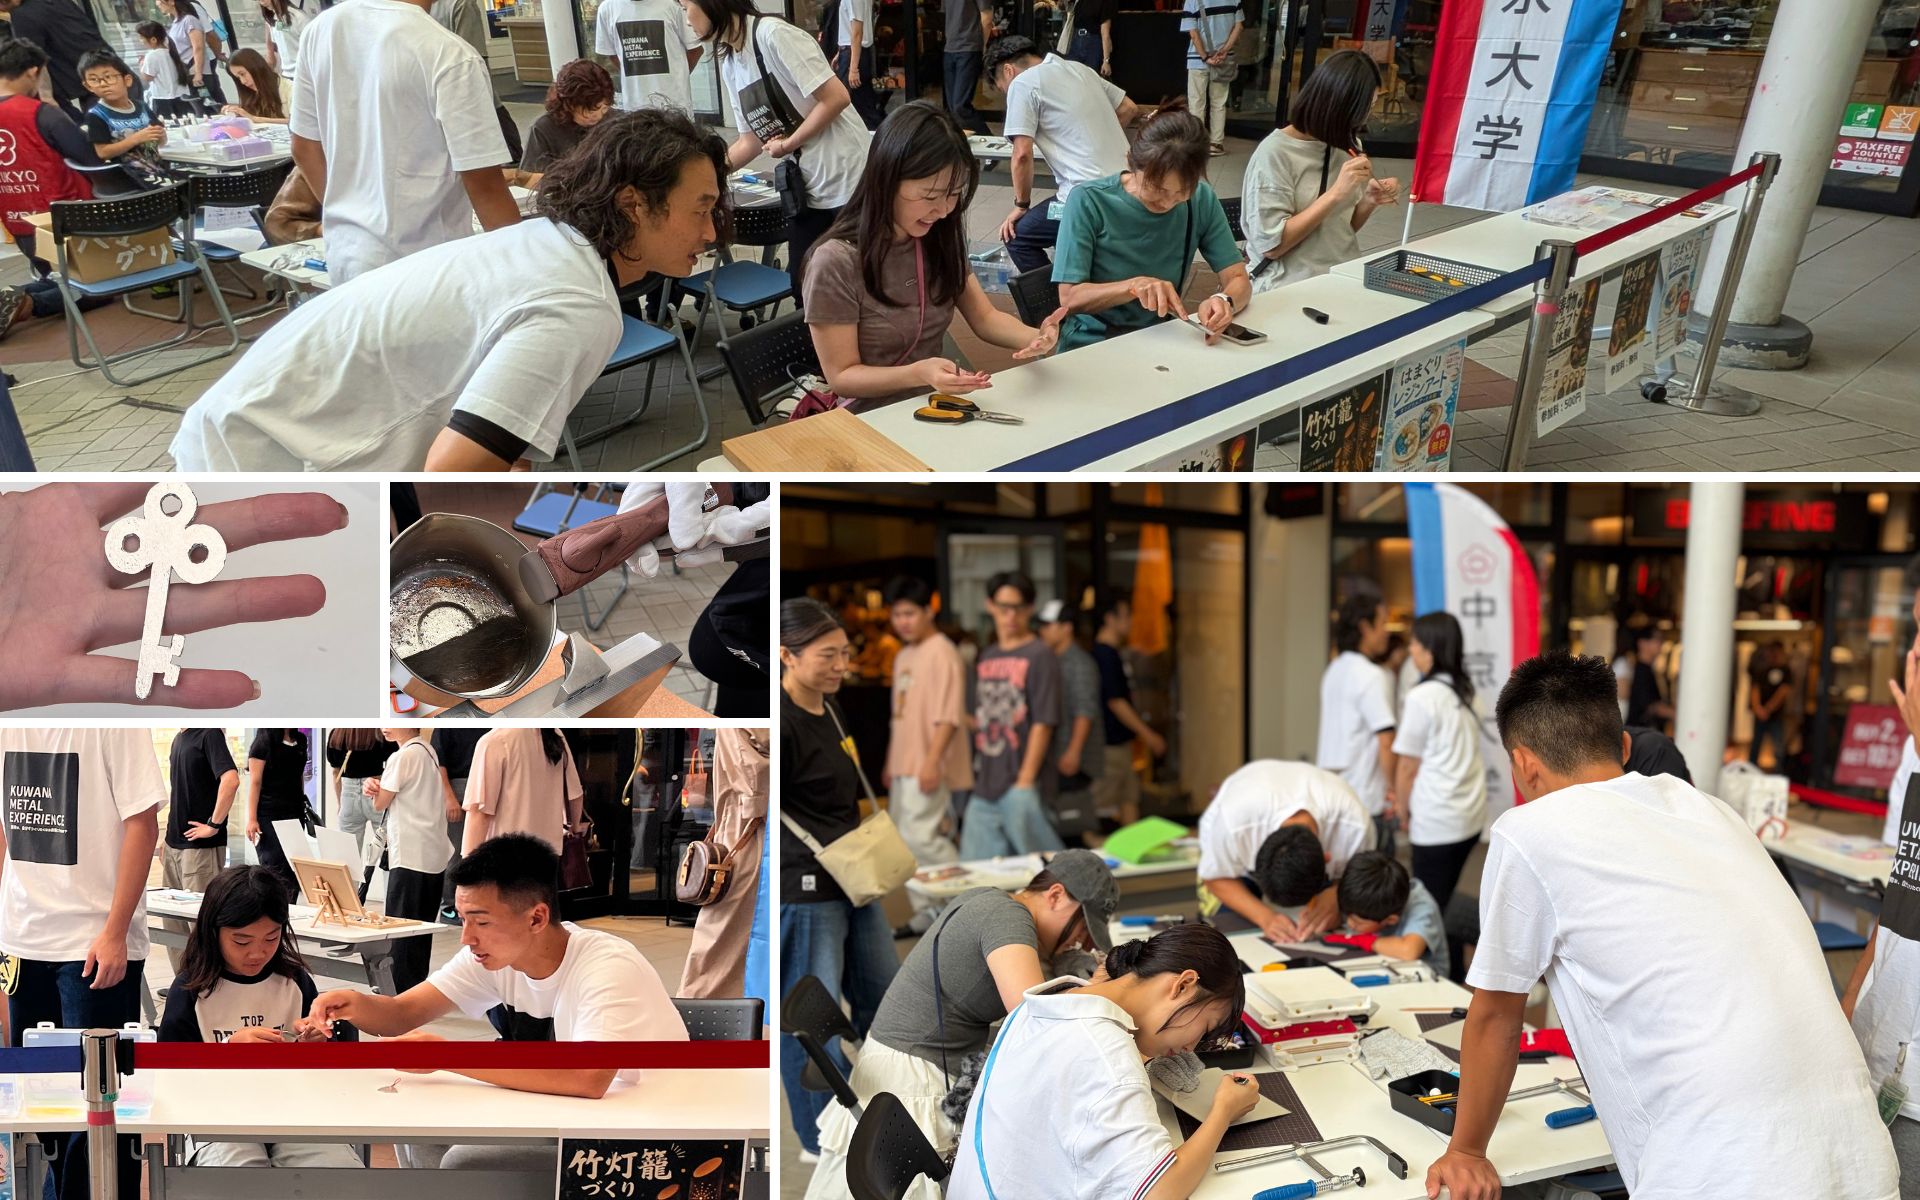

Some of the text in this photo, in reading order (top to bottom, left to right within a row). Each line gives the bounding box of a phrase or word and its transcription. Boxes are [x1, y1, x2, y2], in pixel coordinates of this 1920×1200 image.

[1852, 150, 1902, 161] COUNTER
[1854, 142, 1906, 154] TAXFREE
[1401, 355, 1442, 387] はまぐり
[1393, 370, 1447, 408] レジンアート
[1305, 396, 1353, 437] 竹灯籠
[1310, 430, 1336, 451] づくり
[10, 784, 52, 799] KUWANA
[9, 798, 43, 811] METAL
[9, 811, 65, 827] EXPERIENCE
[241, 1015, 264, 1027] TOP
[568, 1148, 673, 1181] 竹灯籠
[581, 1180, 635, 1198] づくり
